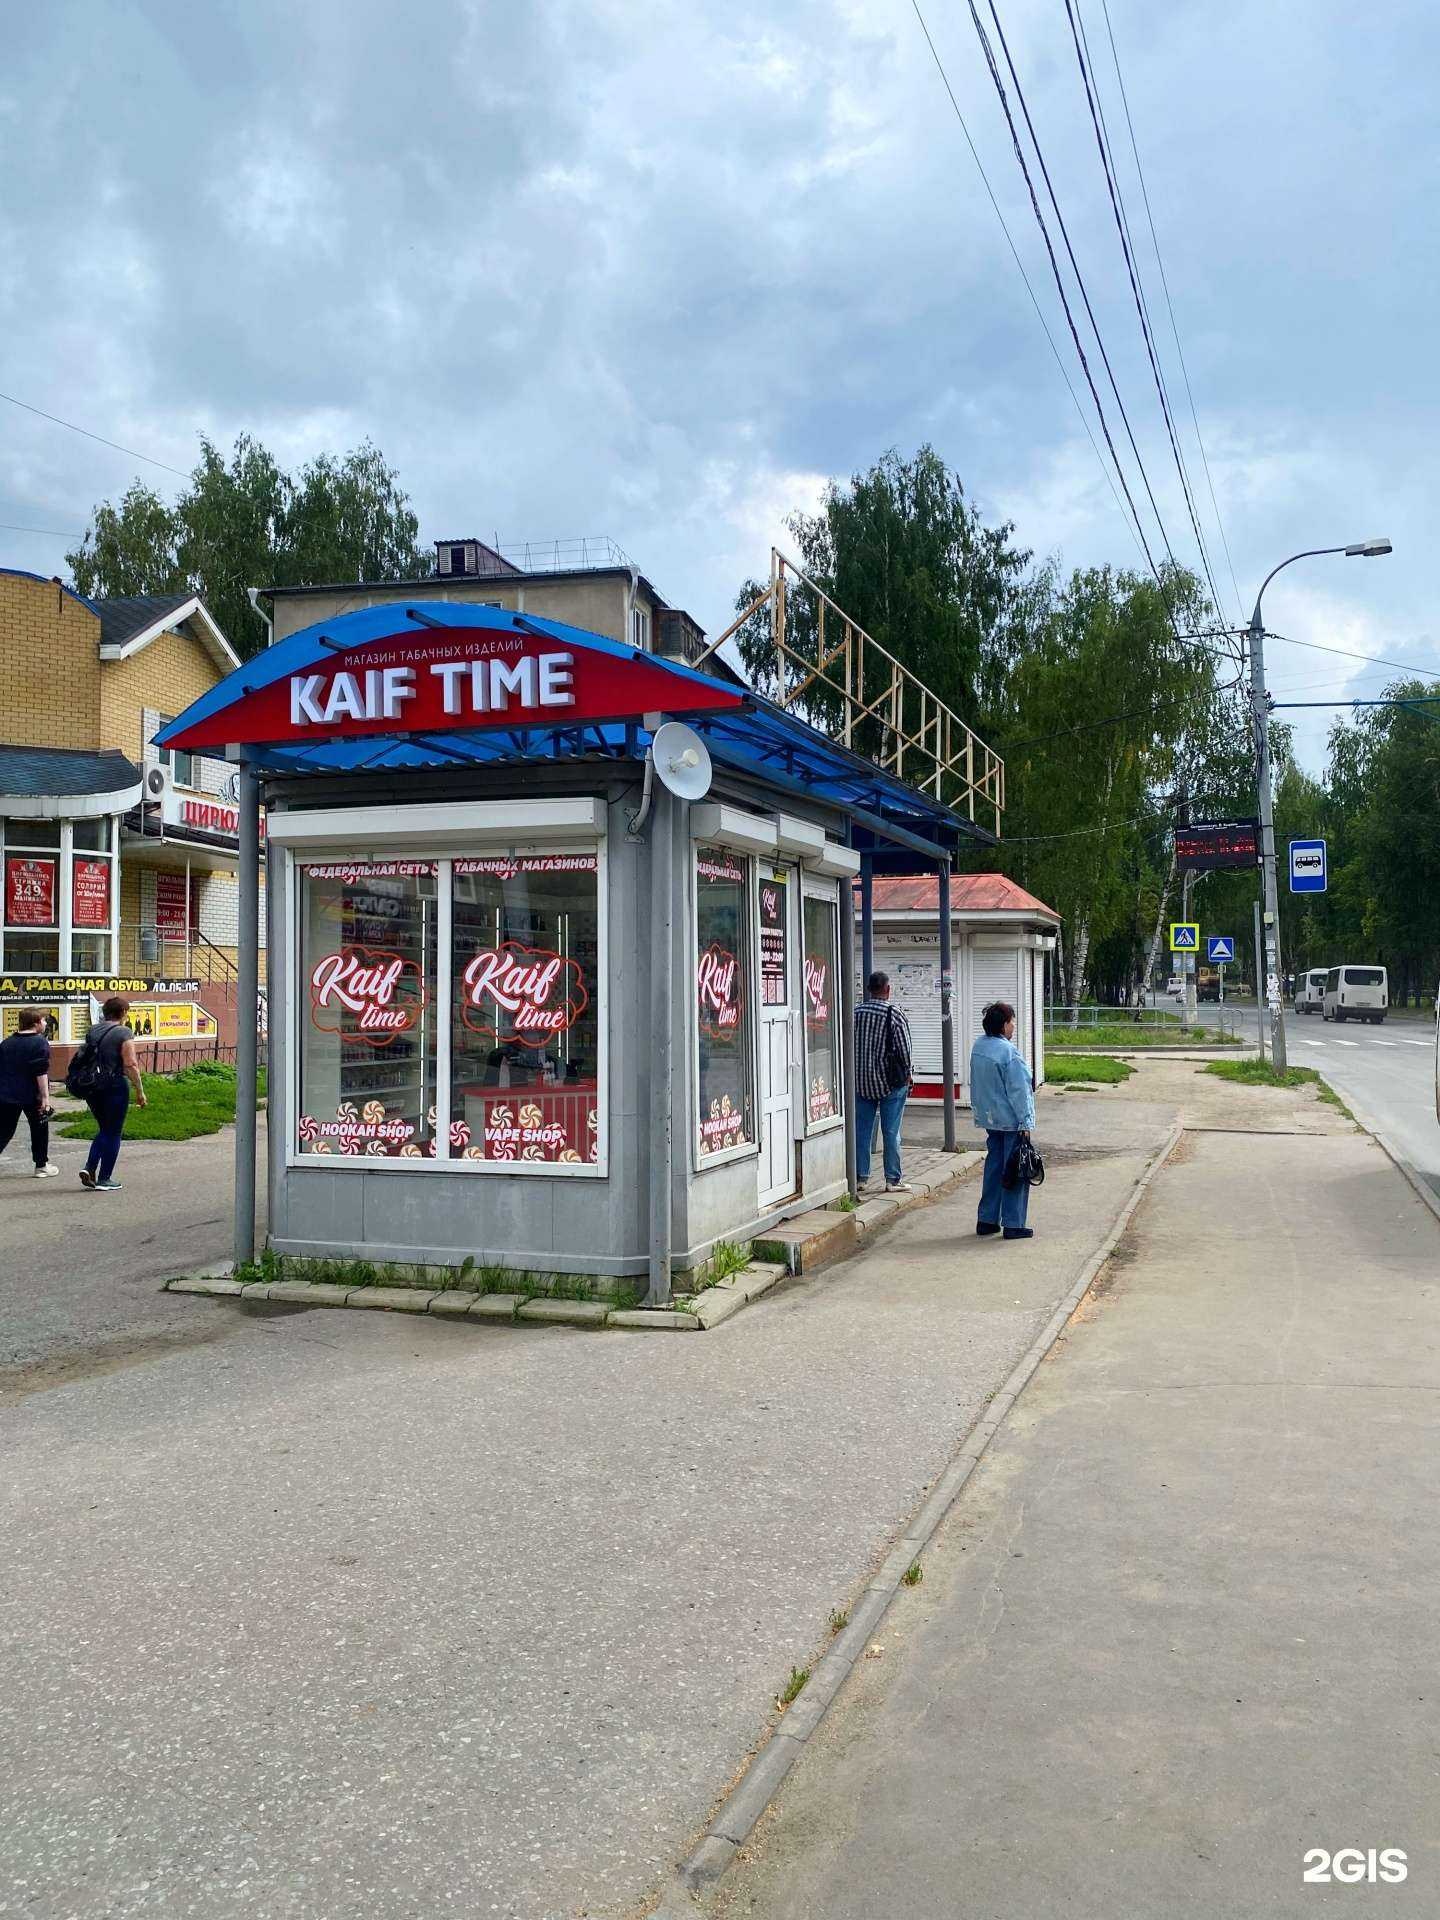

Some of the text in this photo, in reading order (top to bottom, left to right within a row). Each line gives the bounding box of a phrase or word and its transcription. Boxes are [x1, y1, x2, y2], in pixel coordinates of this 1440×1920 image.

[344, 637, 523, 667] МАГАЗИН ТАБАЧНЫХ ИЗДЕЛИЙ
[291, 652, 575, 724] KAIF TIME
[309, 863, 429, 878] ФЕДЕРАЛЬНАЯ СЕТЬ
[455, 857, 597, 873] ТАБАЧНЫХ МАГАЗИНОВ
[26, 978, 105, 991] РАБОЧАЯ
[109, 979, 148, 992] ОБУВЬ
[312, 955, 402, 1011] Kaif
[465, 952, 561, 1010] Kaif
[699, 953, 734, 1008] Kaif
[804, 959, 826, 1005] Kaif
[360, 1002, 407, 1028] time
[515, 1002, 565, 1028] time
[719, 1001, 737, 1024] time
[320, 1122, 414, 1138] HOOKAH SHOP
[485, 1128, 562, 1142] VAPE SHOP
